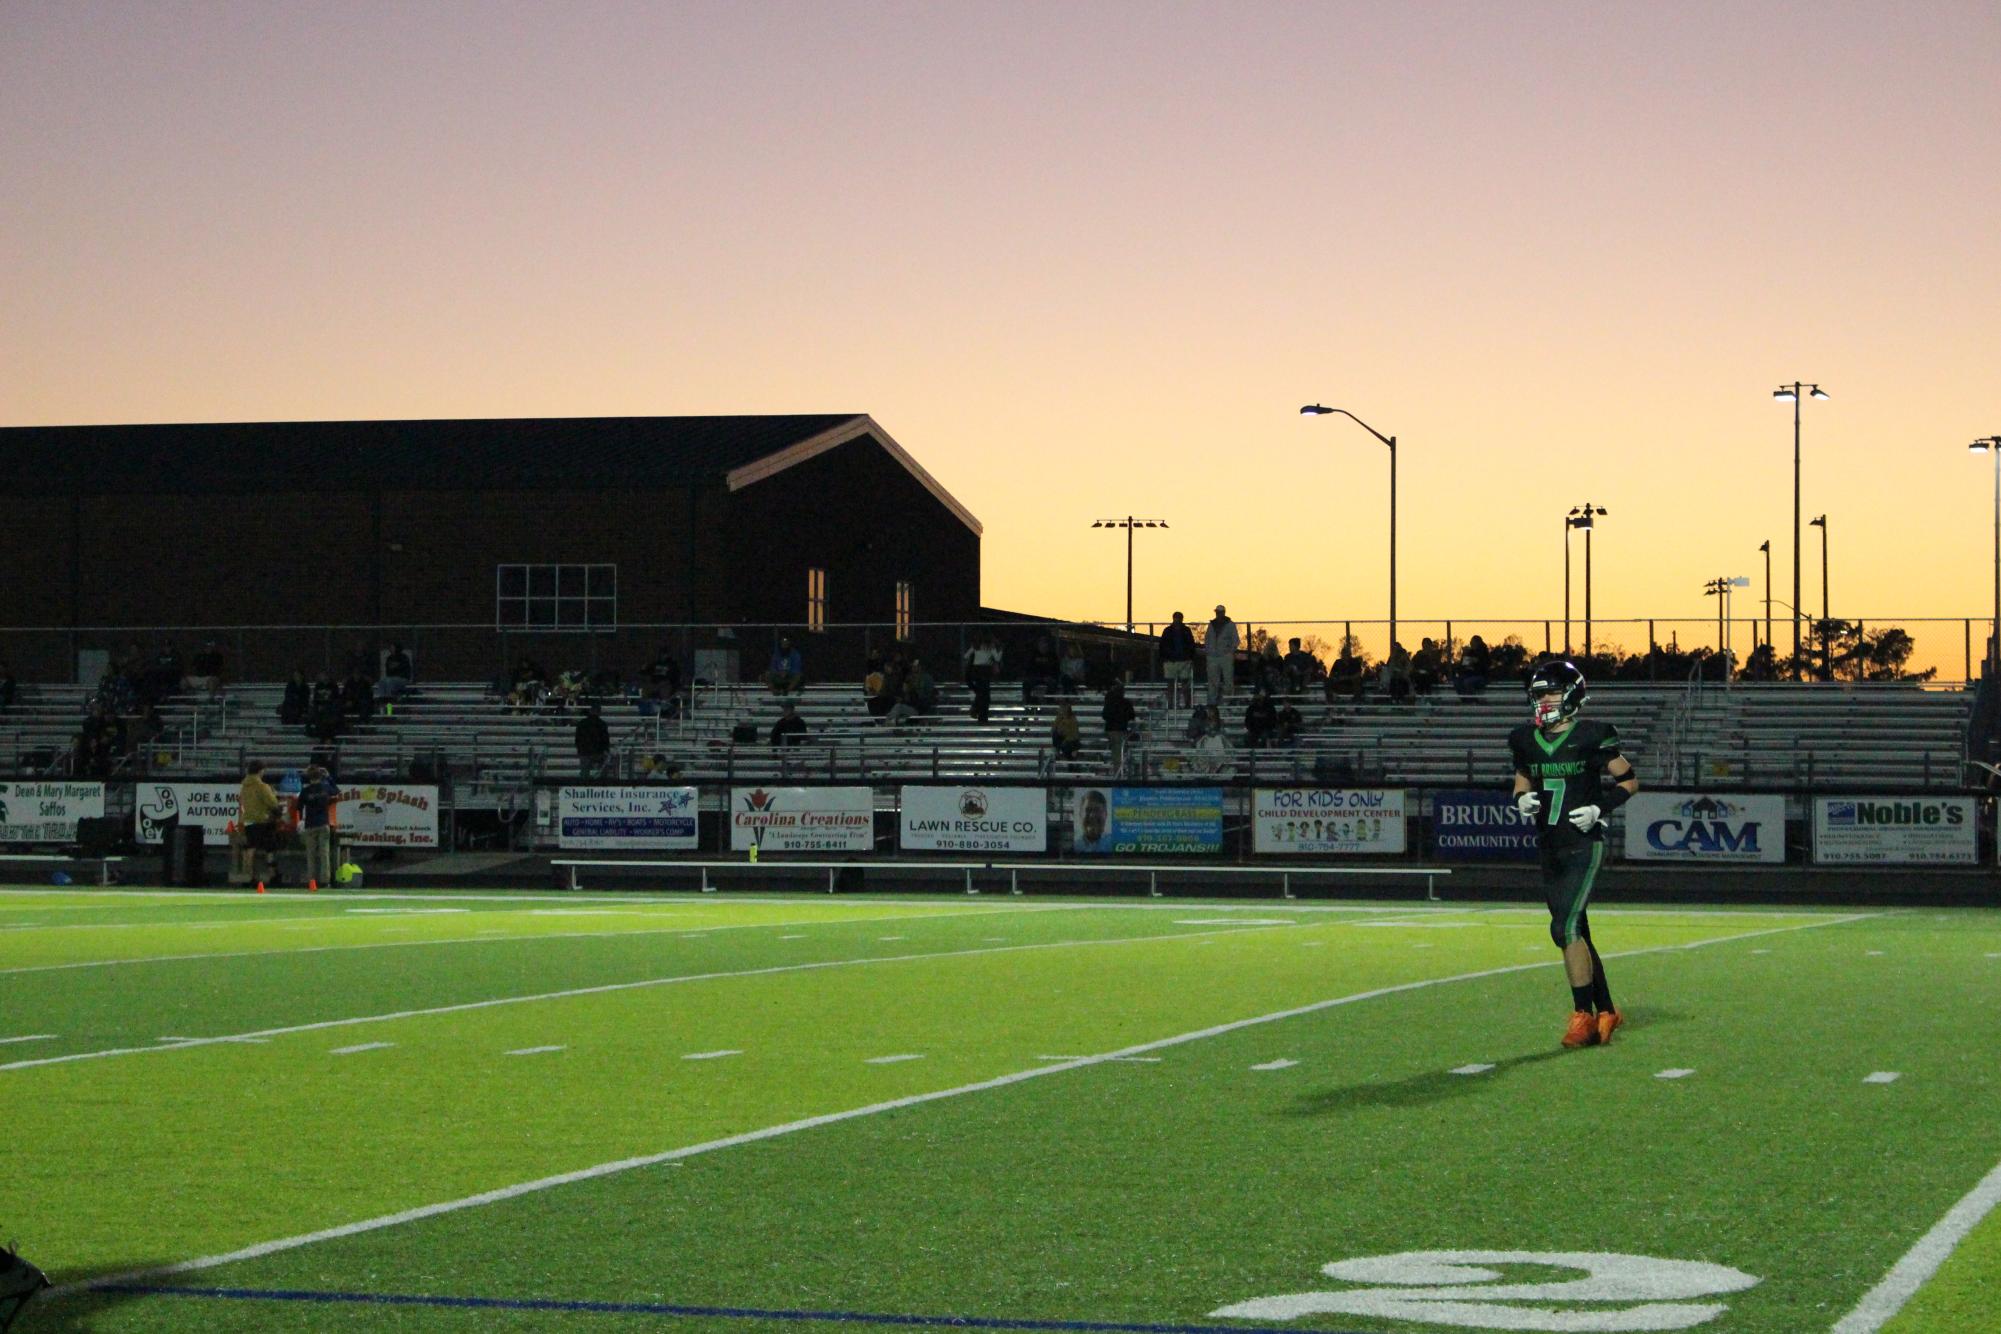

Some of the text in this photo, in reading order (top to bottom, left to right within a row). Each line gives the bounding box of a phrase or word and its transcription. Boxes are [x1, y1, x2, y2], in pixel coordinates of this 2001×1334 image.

[15, 784, 101, 801] Dean & Mary Margaret
[186, 792, 209, 803] JOE
[214, 792, 222, 803] &
[376, 787, 428, 811] Splash
[564, 788, 680, 800] Shallotte Insurance
[1274, 790, 1385, 807] FOR KIDS ONLY
[39, 801, 66, 817] Saffos
[572, 802, 651, 814] Services, Inc.
[1543, 778, 1566, 826] 7
[186, 806, 240, 817] AUTOMOT
[1258, 809, 1401, 818] CHILD DEVELOPMENT CENTER
[1440, 804, 1537, 826] BRUNSW
[1857, 801, 1964, 825] Noble's
[735, 811, 870, 827] Carolina Creations
[909, 820, 1037, 833] LAWN RESCUE CO.
[1438, 835, 1520, 848] COMMUNITY
[1646, 819, 1762, 853] CAM
[936, 840, 1010, 849] 910-880-3054
[1115, 842, 1220, 853] GO TROJANS!!!
